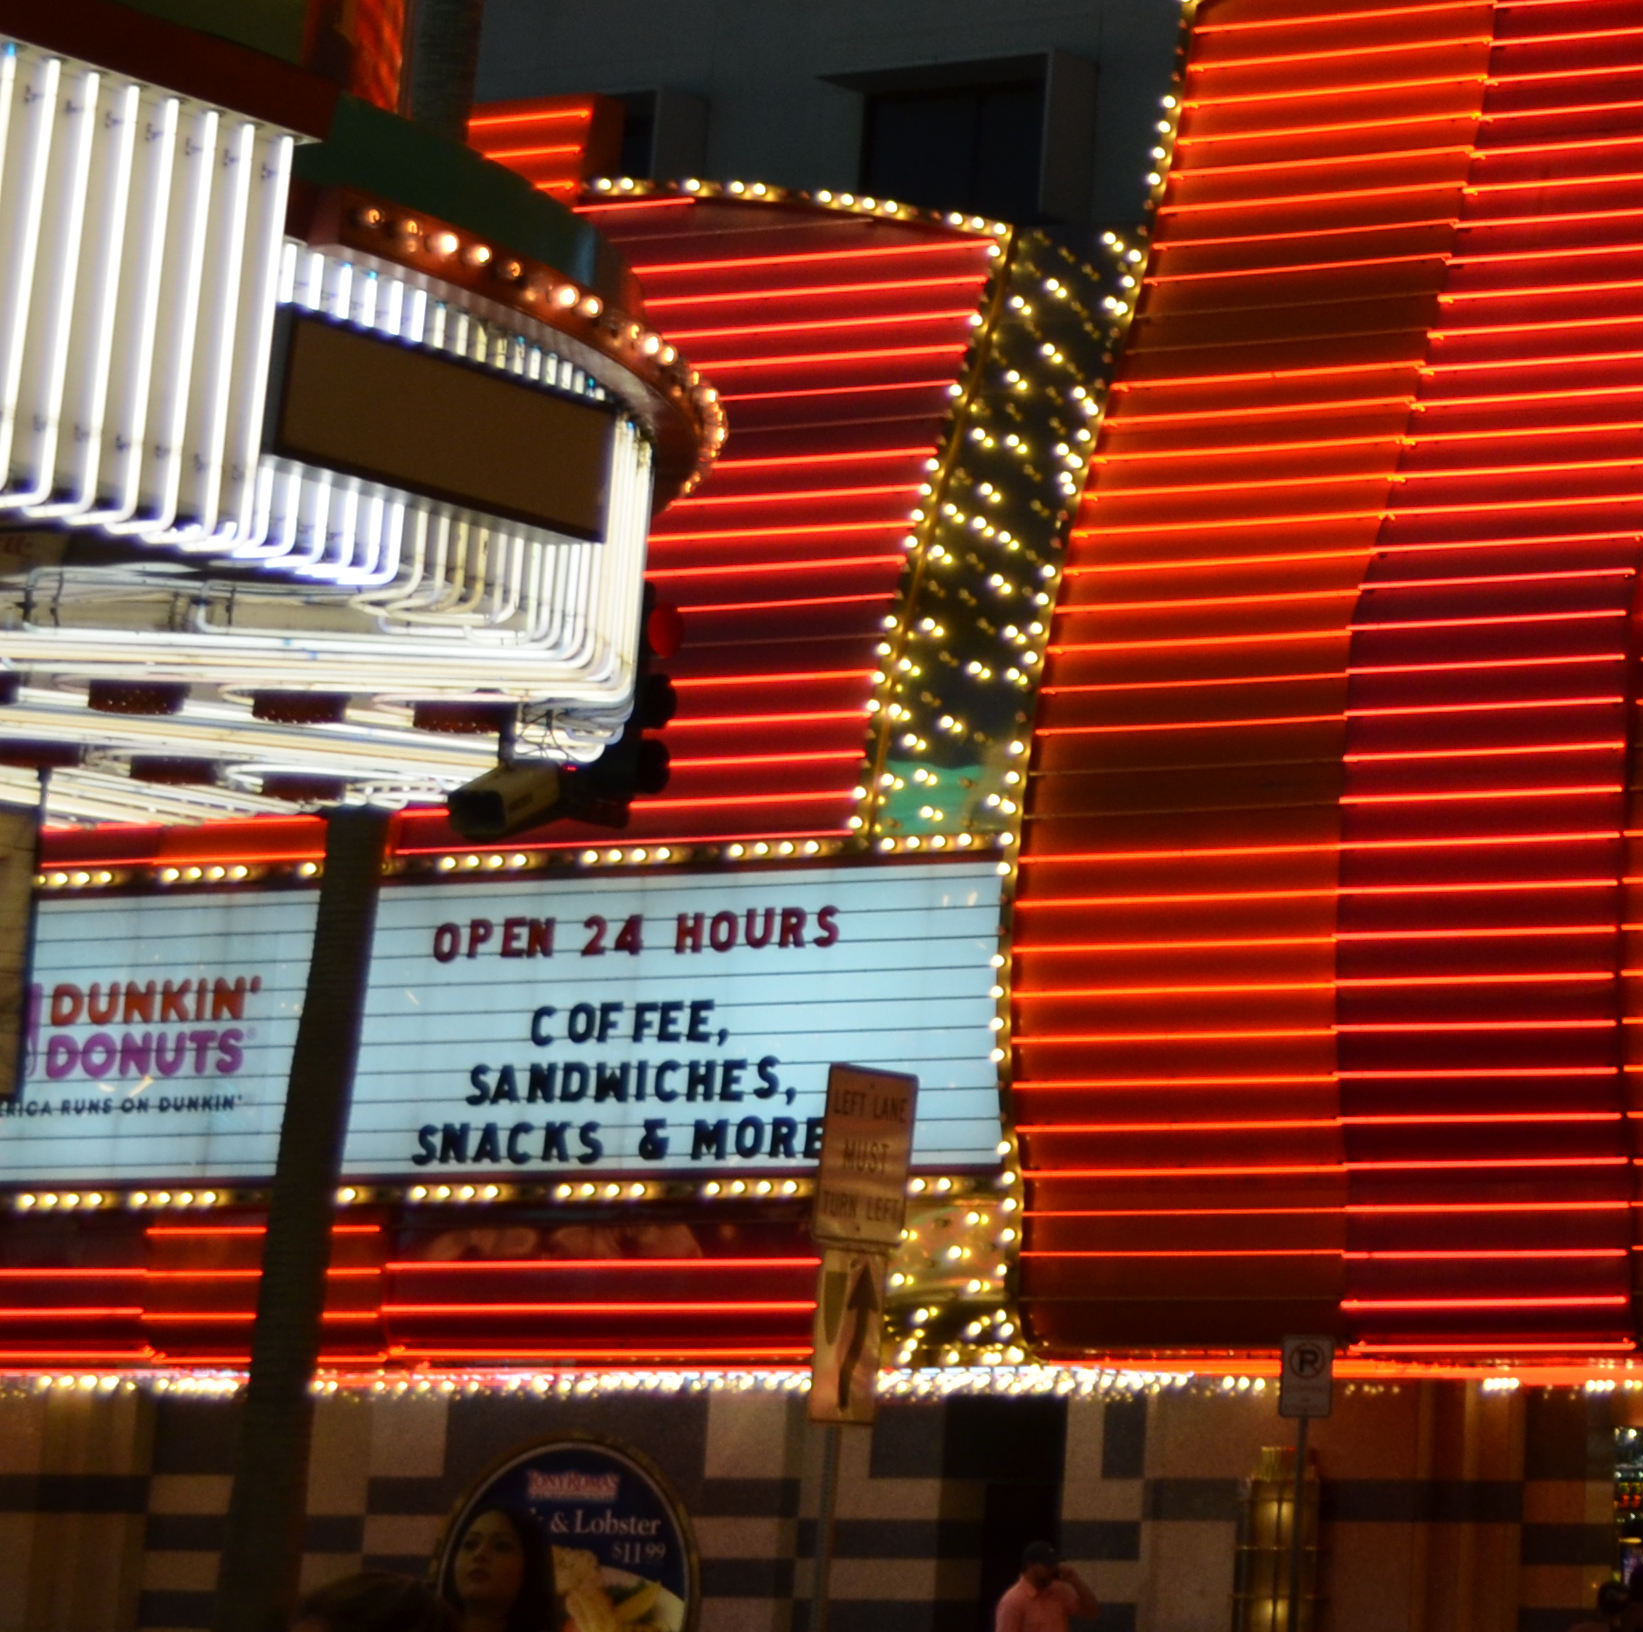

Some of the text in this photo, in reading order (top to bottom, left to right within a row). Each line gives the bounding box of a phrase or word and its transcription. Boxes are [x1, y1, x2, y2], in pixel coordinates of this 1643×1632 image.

[433, 904, 841, 963] OPEN 24 HOURS
[51, 975, 262, 1027] DUNKIN'
[530, 999, 731, 1047] COFFEE,
[46, 1028, 245, 1079] DONUTS
[465, 1055, 799, 1107] SANDWICHES,
[0, 1094, 243, 1119] RICA RUNS ON DUNKIN'
[833, 1089, 908, 1123] LEFT LANE
[411, 1115, 825, 1166] SNACKS & MORE
[843, 1139, 890, 1174] MUST
[822, 1190, 901, 1223] TURN LEFT
[550, 1512, 570, 1533] &
[574, 1509, 662, 1535] Lobster
